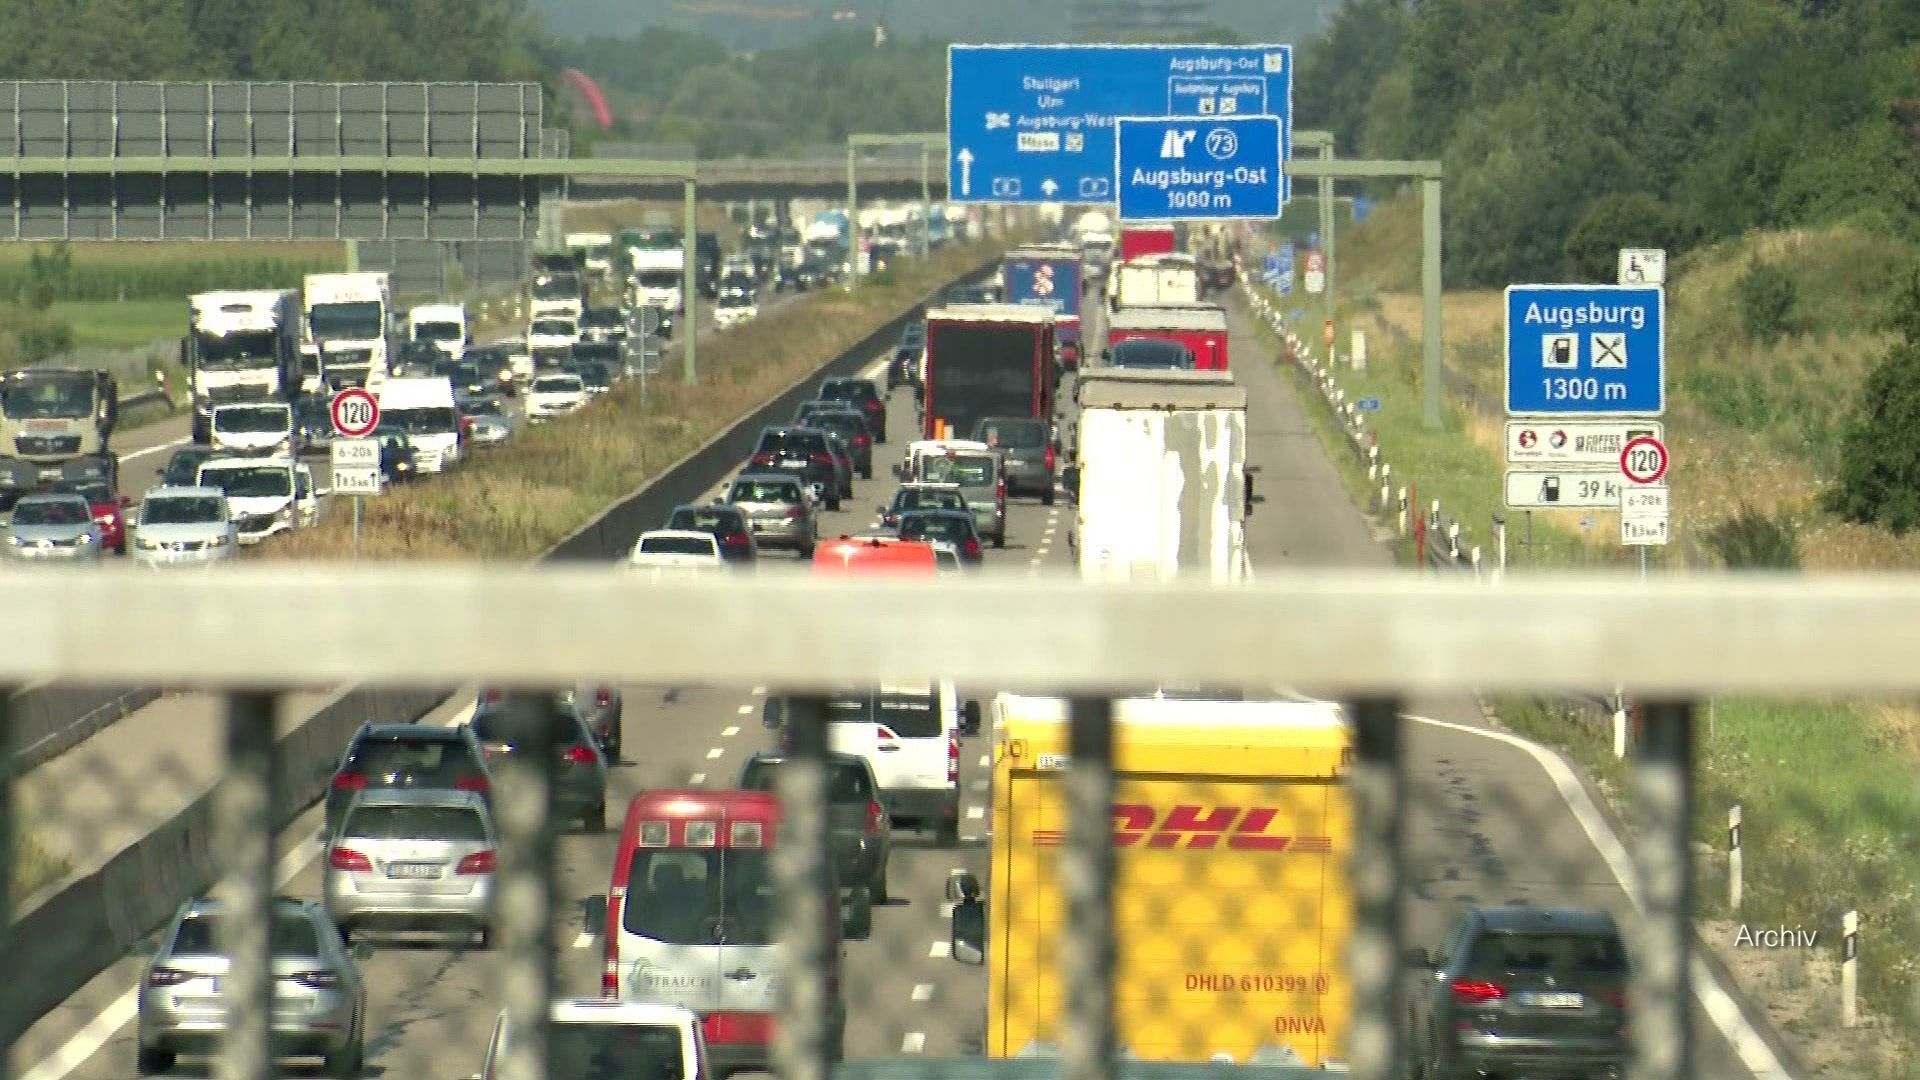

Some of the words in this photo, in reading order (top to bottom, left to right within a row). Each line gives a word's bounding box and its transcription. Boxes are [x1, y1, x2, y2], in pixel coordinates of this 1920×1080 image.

[1211, 134, 1234, 152] 73
[1132, 167, 1267, 189] Augsburg-Ost
[1167, 191, 1210, 208] 1000
[1213, 194, 1231, 208] m
[1524, 302, 1645, 330] Augsburg
[1543, 378, 1598, 400] 1300
[1604, 383, 1627, 400] m
[341, 402, 370, 424] 120
[1630, 449, 1659, 472] 120
[1578, 480, 1599, 498] 39
[1605, 480, 1621, 498] k
[1185, 974, 1235, 992] DHLD
[1240, 974, 1307, 992] 610399
[1274, 1016, 1326, 1034] DNVA
